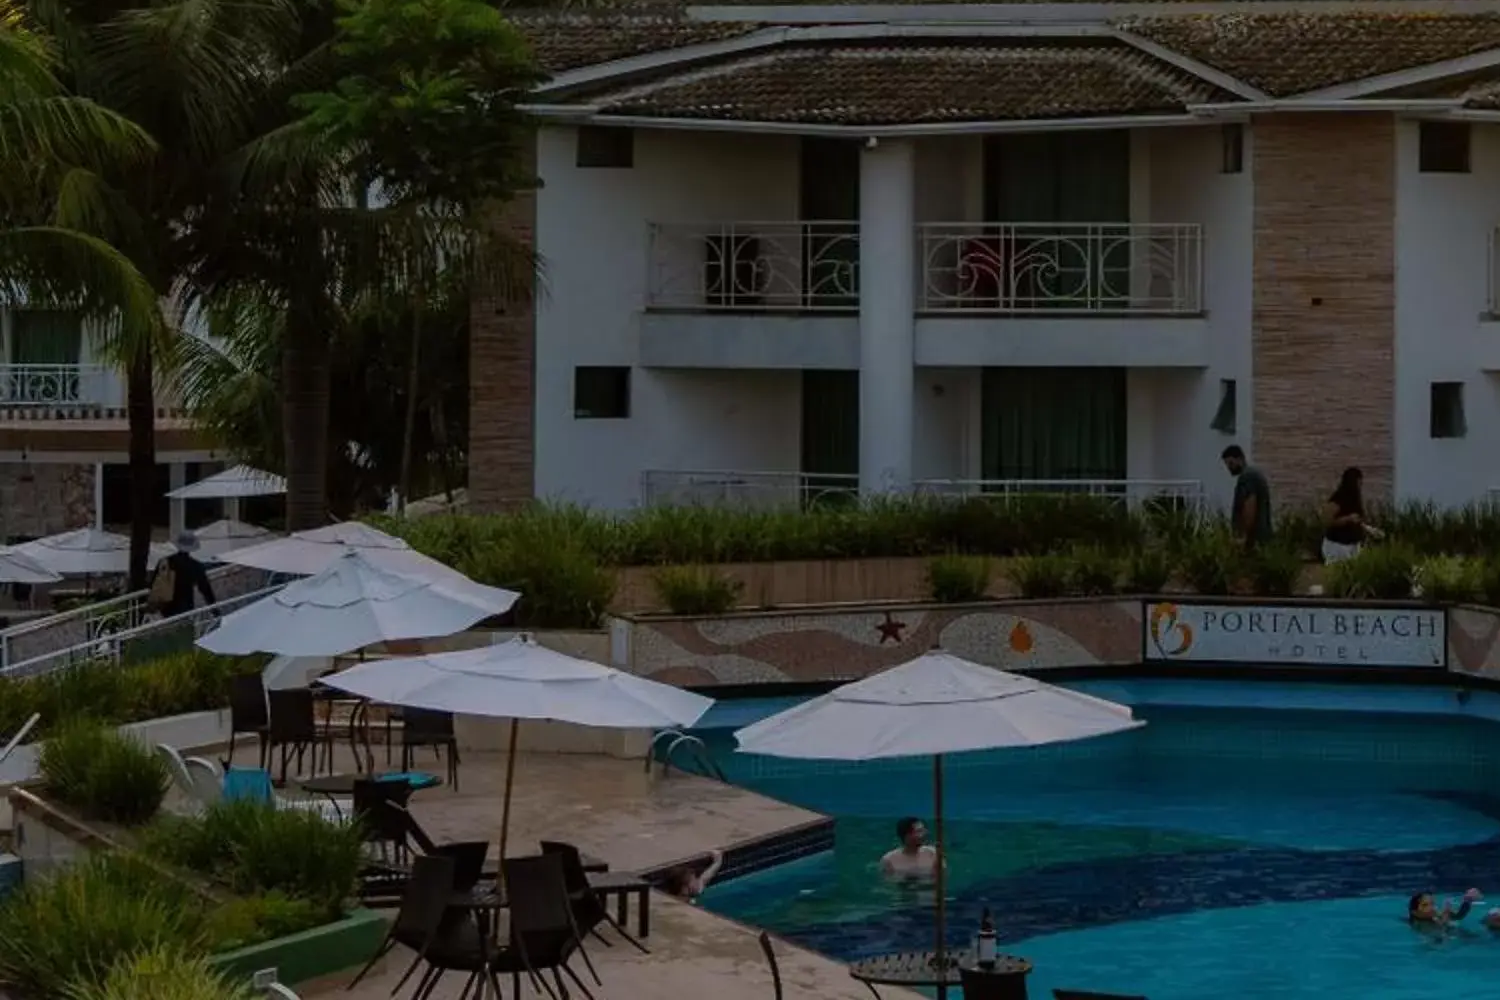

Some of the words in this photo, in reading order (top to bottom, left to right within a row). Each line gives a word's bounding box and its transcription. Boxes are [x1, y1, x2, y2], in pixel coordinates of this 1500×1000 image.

[1203, 610, 1322, 635] PORTAL
[1333, 615, 1436, 638] BEACH
[1267, 646, 1369, 660] HOTEL
